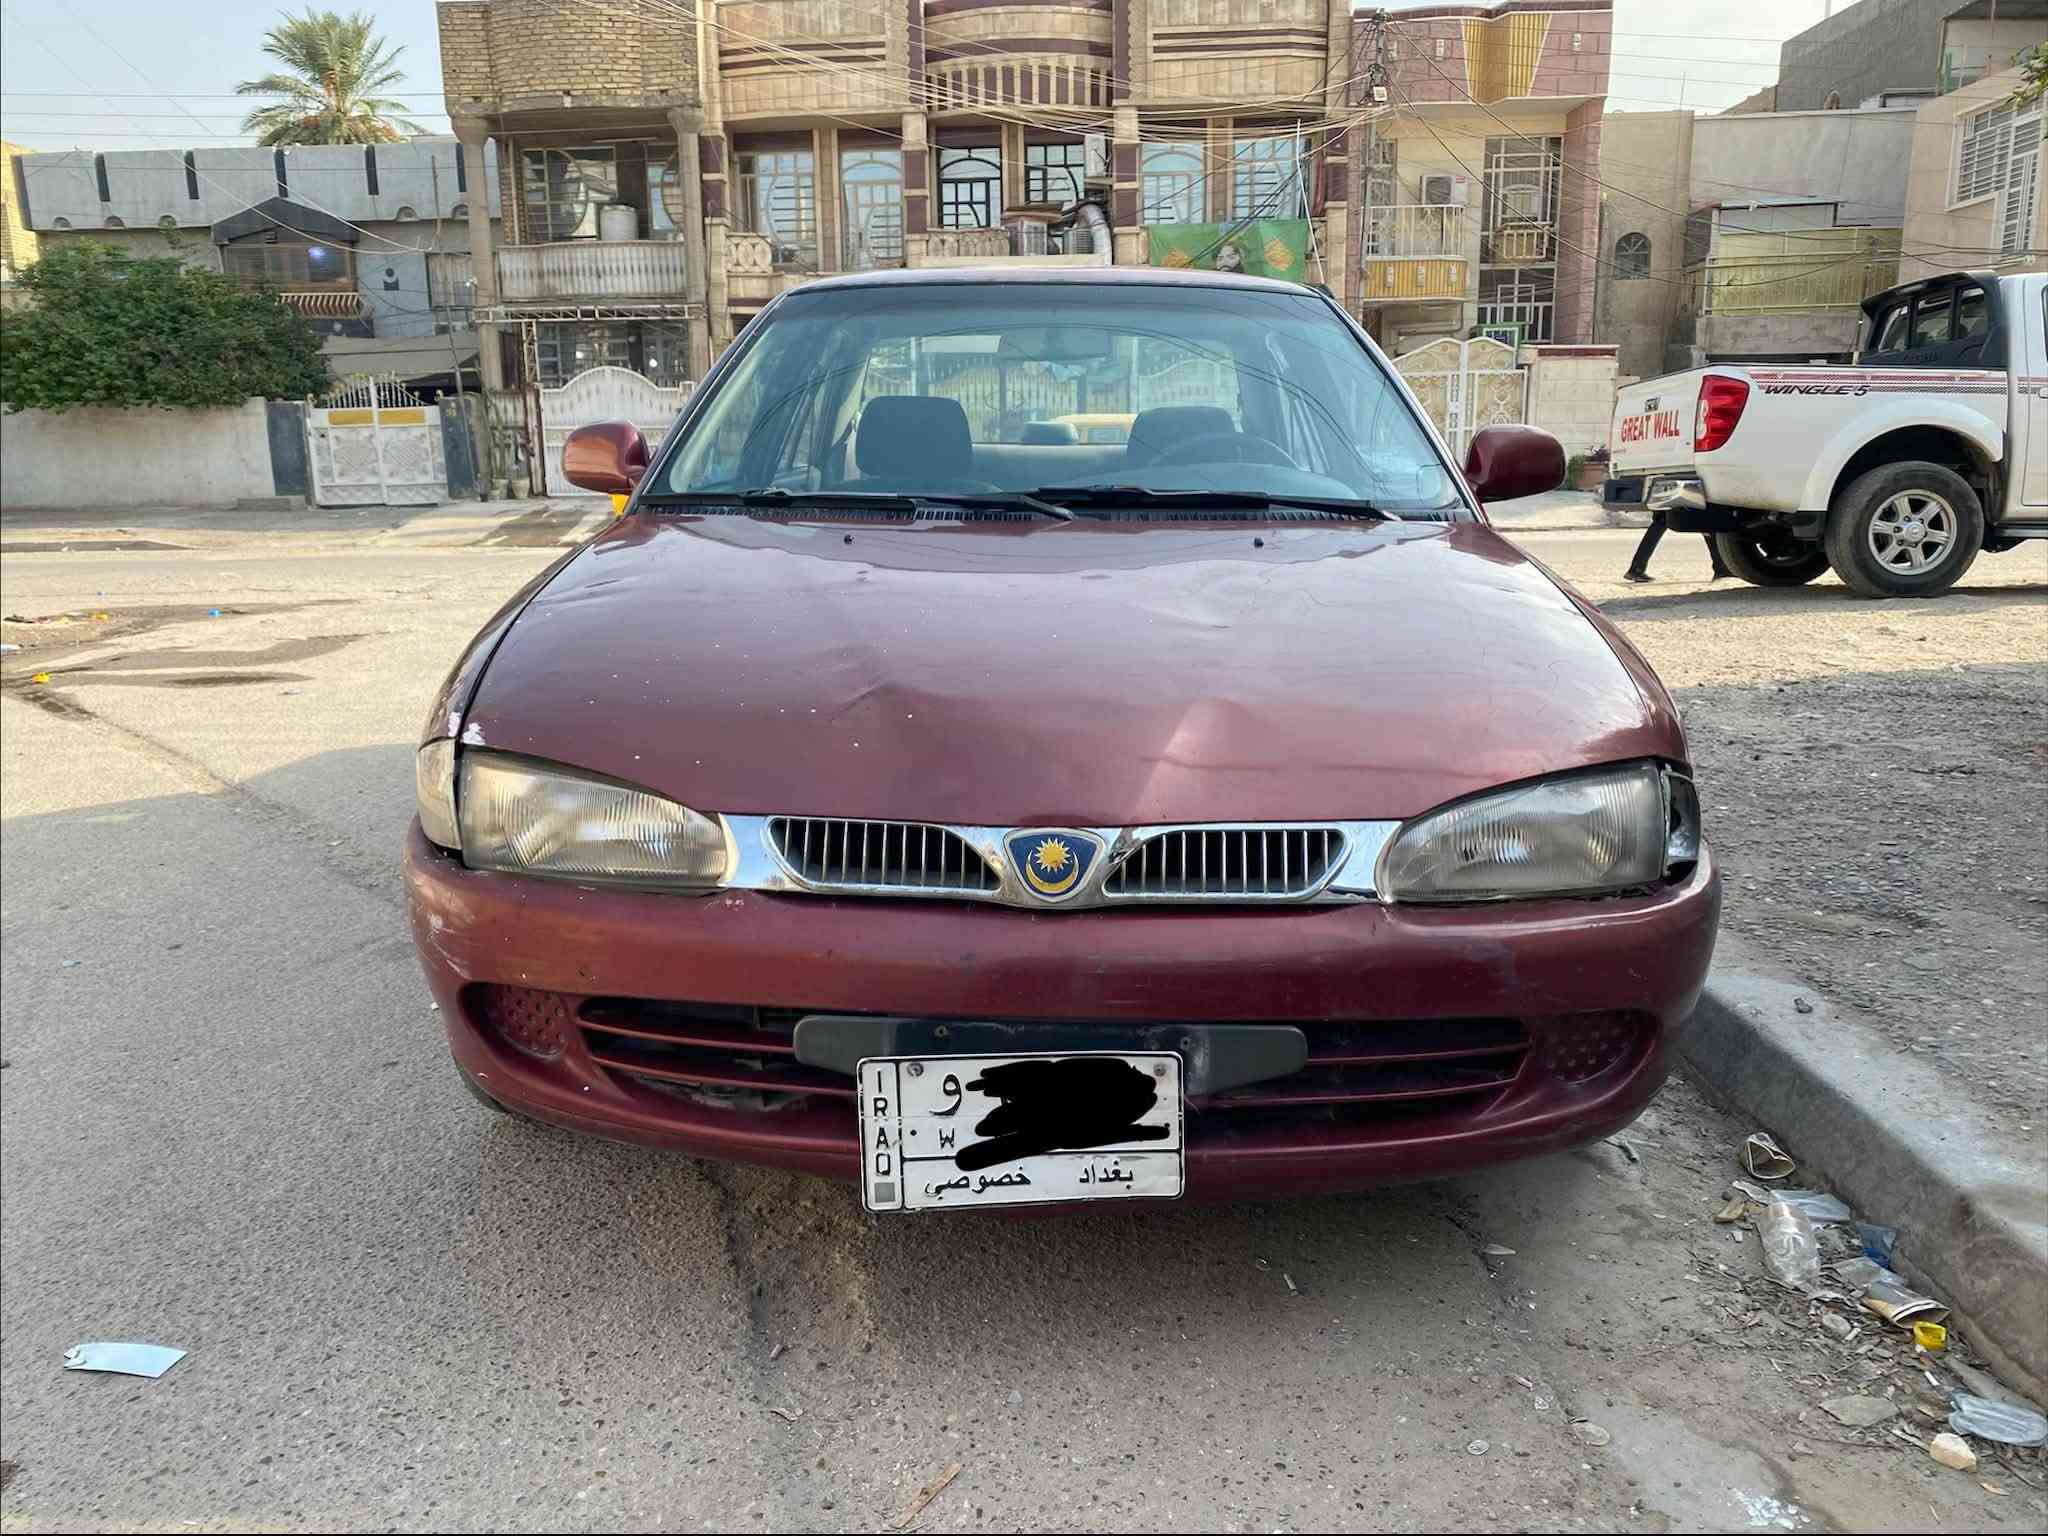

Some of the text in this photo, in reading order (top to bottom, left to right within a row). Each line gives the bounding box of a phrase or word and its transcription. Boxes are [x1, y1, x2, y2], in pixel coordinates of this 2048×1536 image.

[1764, 384, 1872, 397] WINGLE 5
[1621, 409, 1680, 443] GREAT WALL
[873, 1069, 892, 1177] IRAQ
[1079, 1159, 1135, 1190] بغداد
